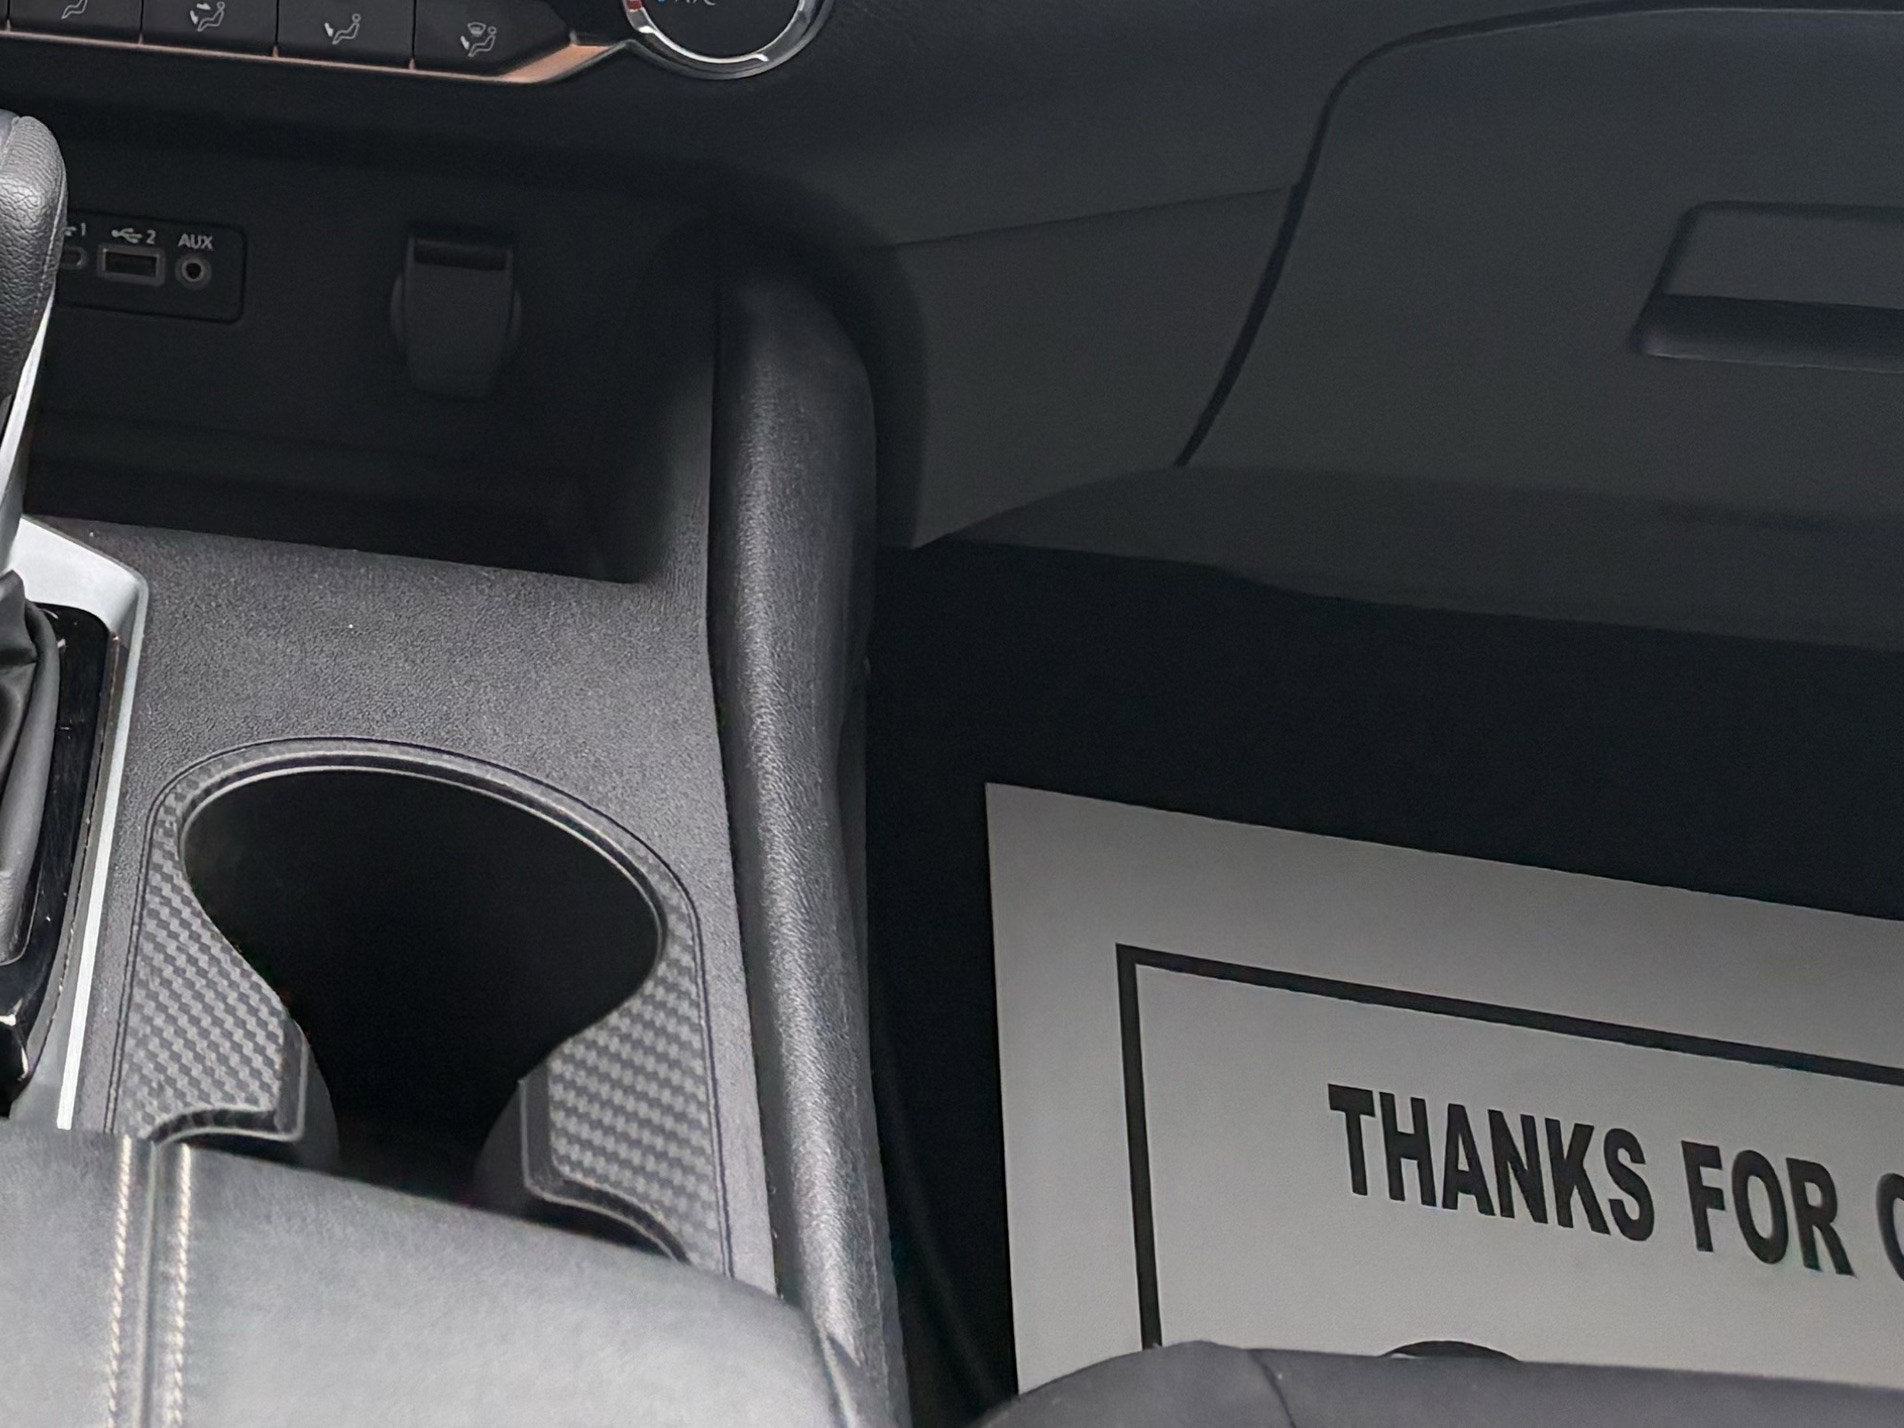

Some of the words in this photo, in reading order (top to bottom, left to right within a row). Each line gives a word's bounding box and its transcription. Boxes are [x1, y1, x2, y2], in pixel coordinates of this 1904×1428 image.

[177, 233, 213, 249] AUX
[1326, 1082, 1655, 1243] THANKS
[1680, 1139, 1856, 1279] FOR
